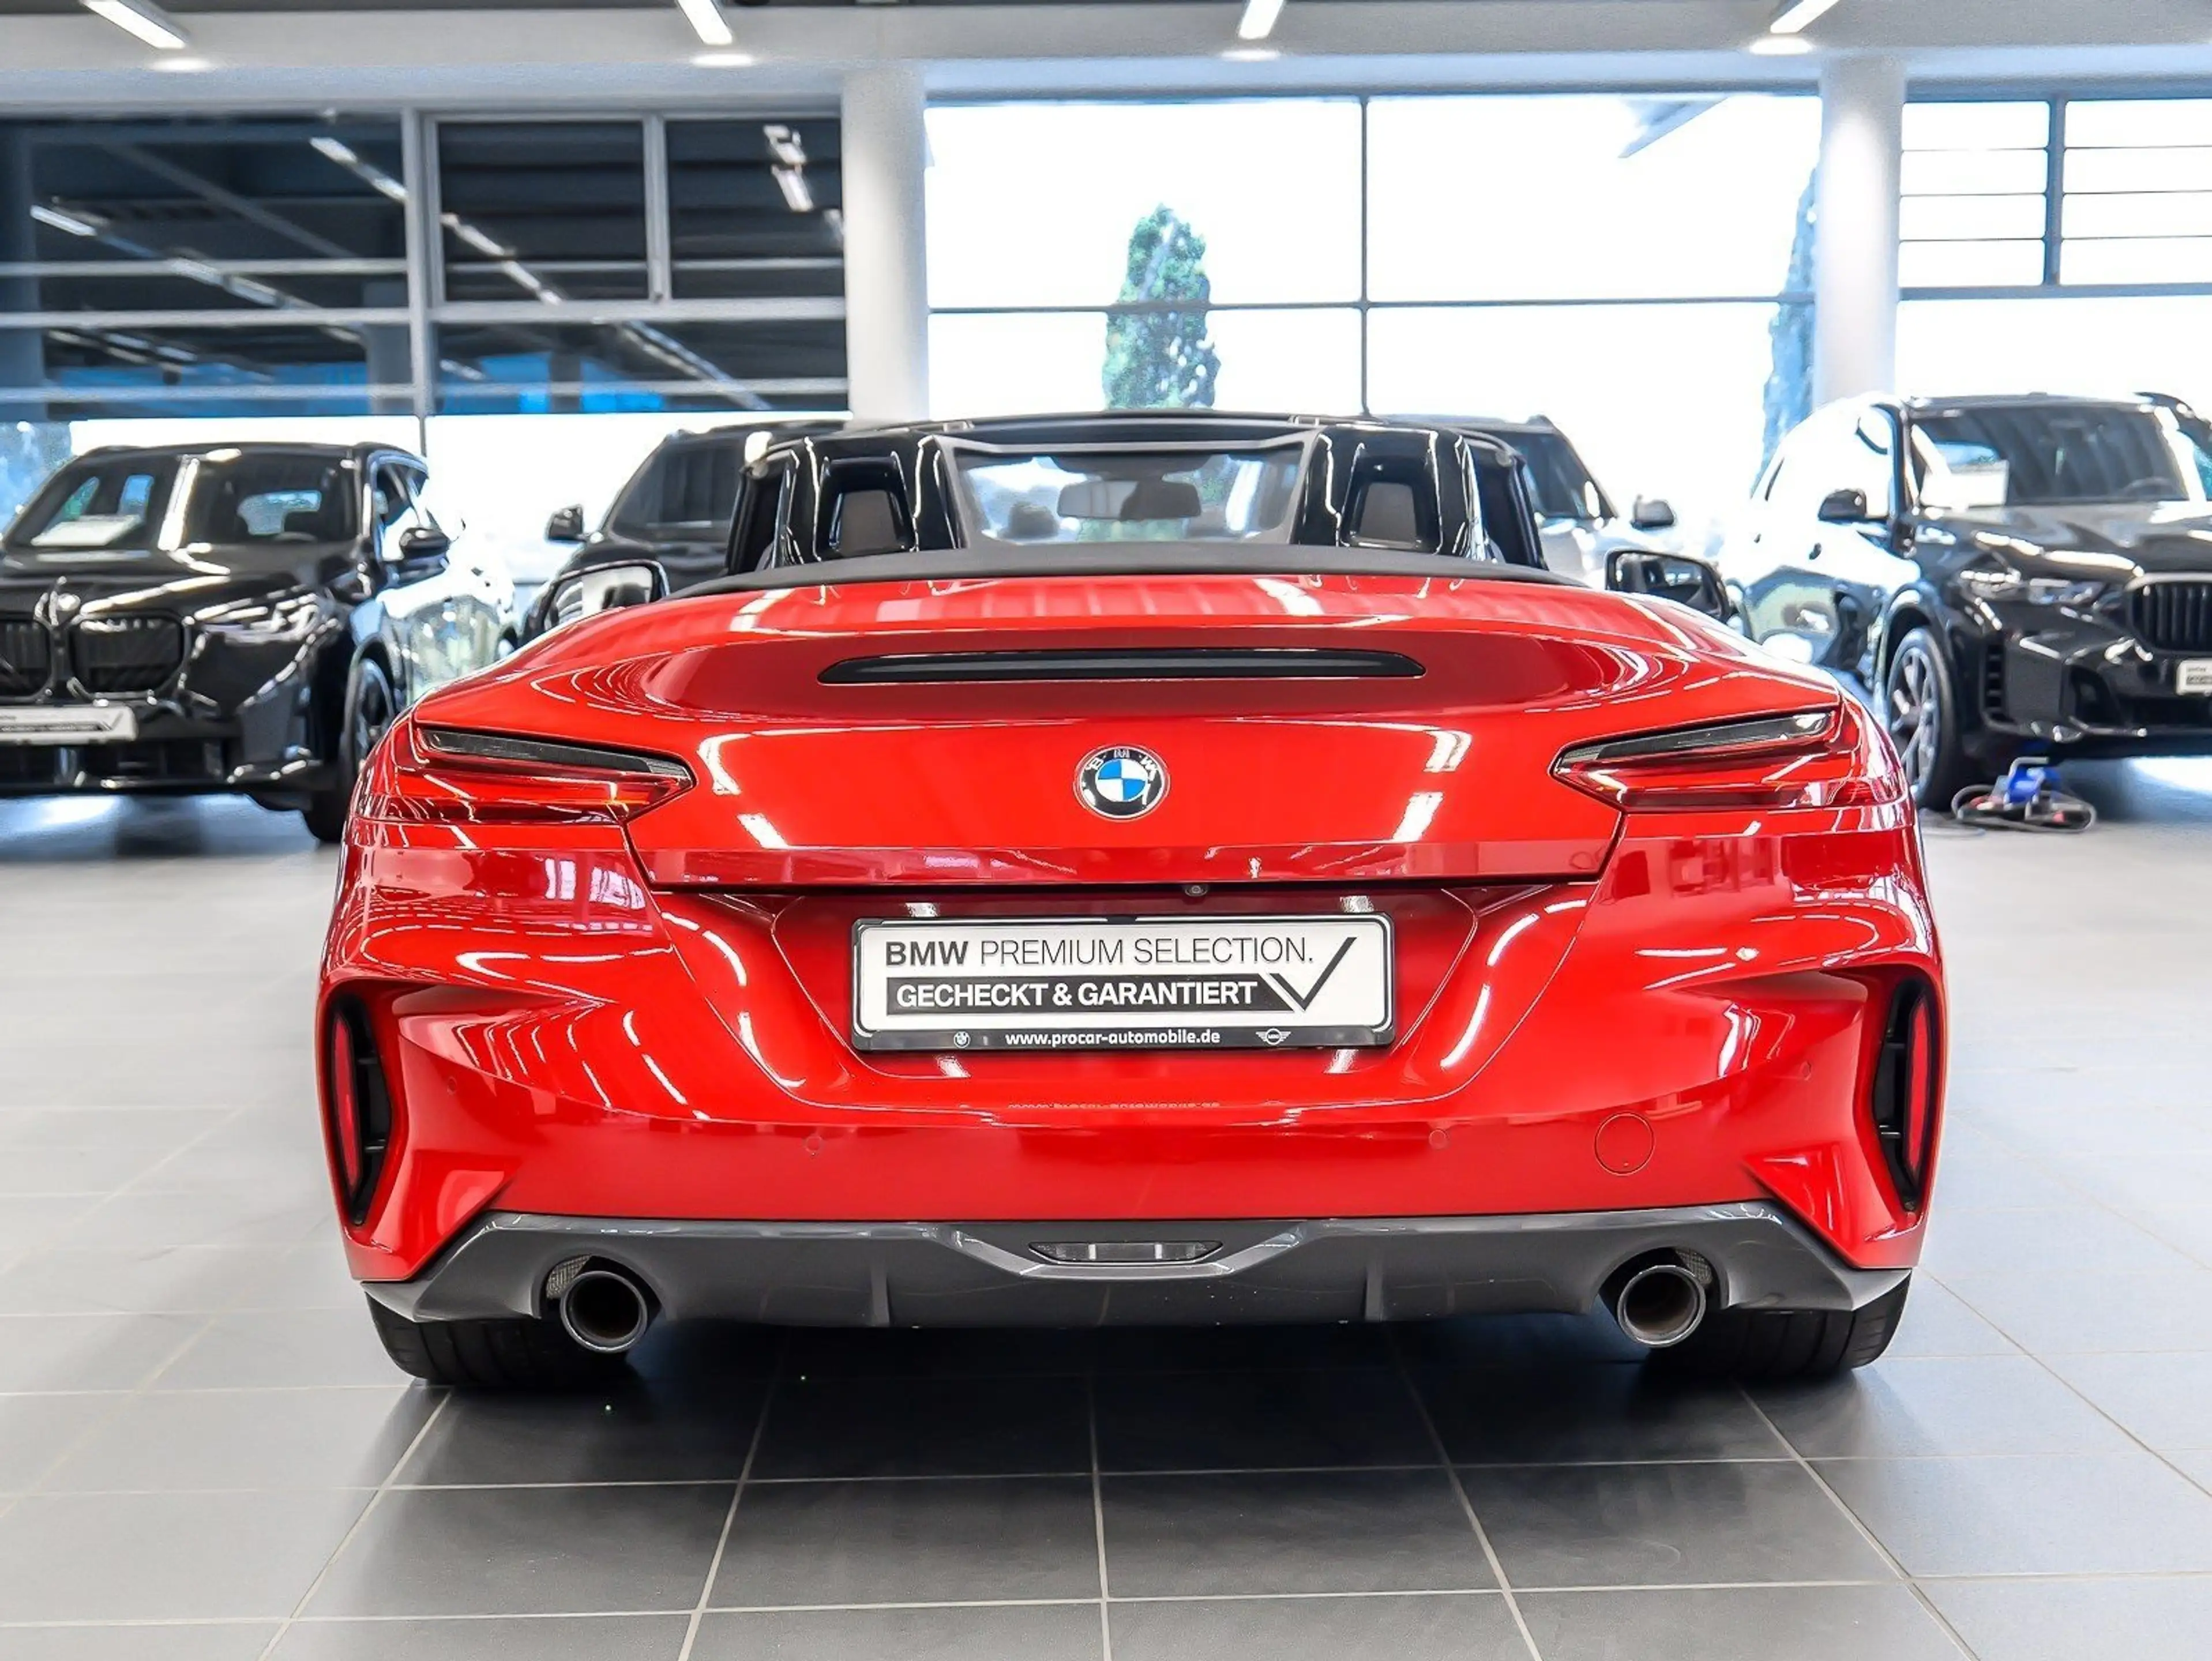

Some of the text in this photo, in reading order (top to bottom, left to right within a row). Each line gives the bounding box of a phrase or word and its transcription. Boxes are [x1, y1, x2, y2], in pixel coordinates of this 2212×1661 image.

[885, 937, 1313, 966] BMW PREMIUM SELECTION.
[896, 980, 1258, 1008] GECHECKT & GARANTIERT
[1005, 1028, 1220, 1048] www.procar-automobile.de
